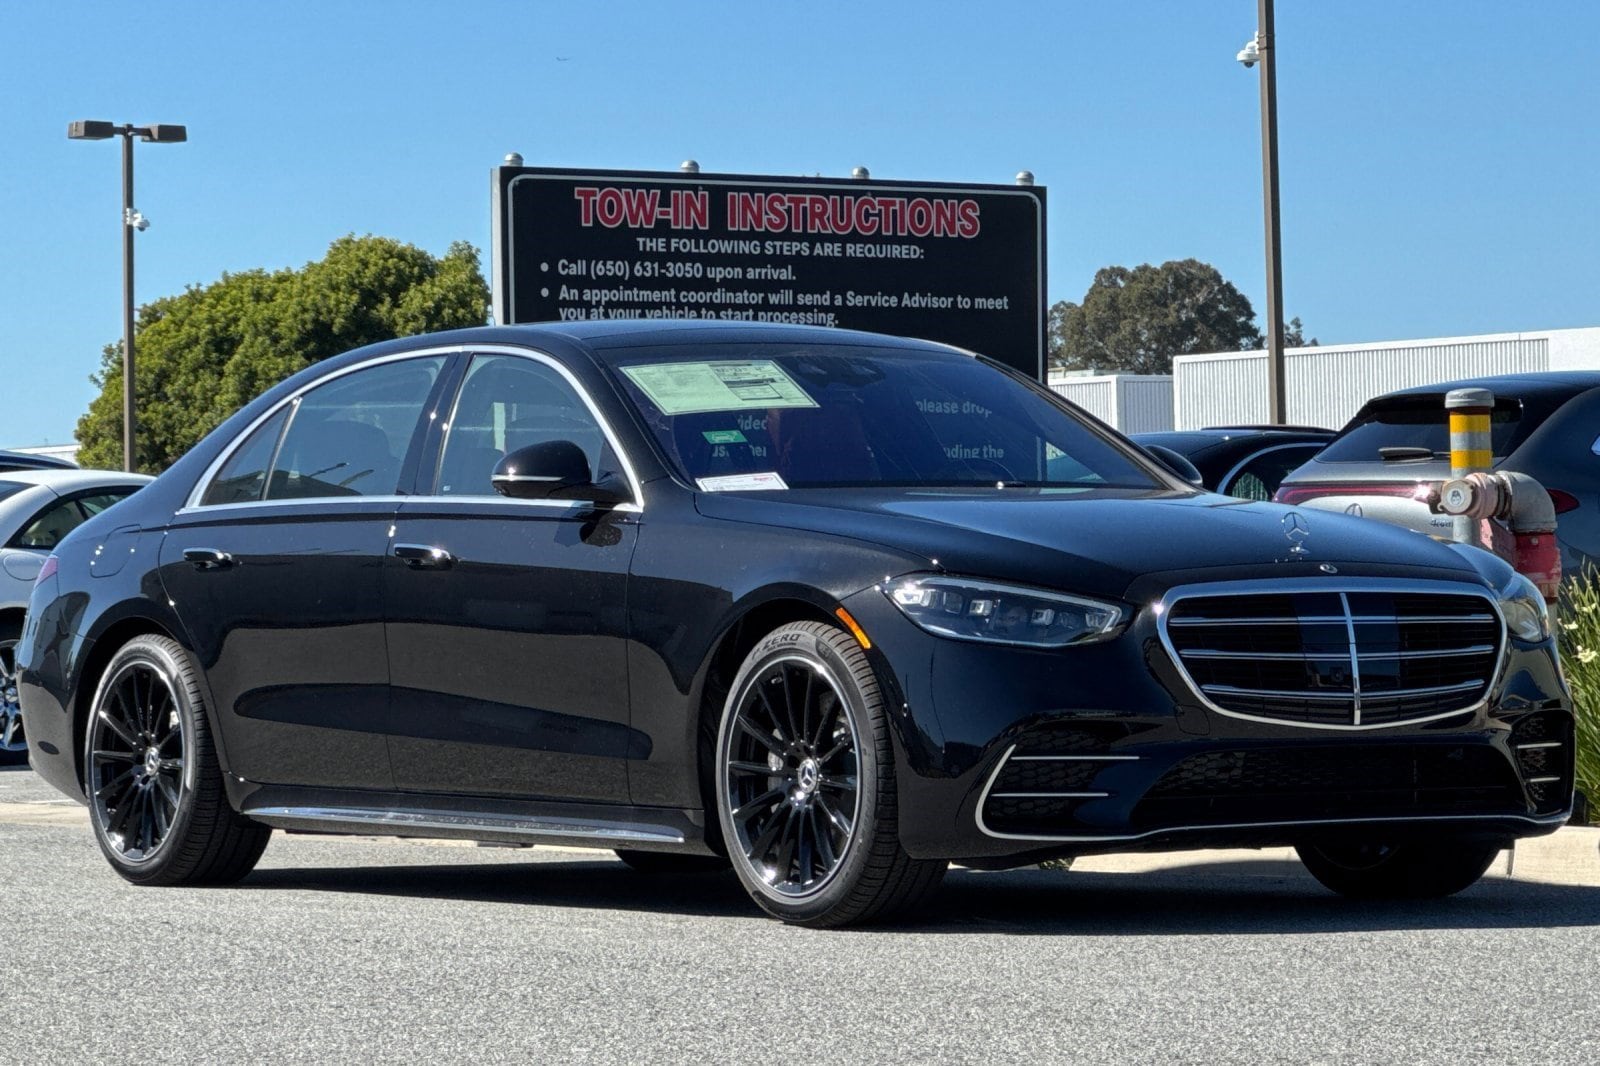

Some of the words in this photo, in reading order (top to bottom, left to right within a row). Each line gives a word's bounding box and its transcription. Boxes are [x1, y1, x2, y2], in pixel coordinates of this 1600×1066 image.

[574, 187, 709, 230] TOW-IN
[727, 191, 980, 239] INSTRUCTIONS
[636, 237, 667, 252] THE
[670, 239, 761, 254] FOLLOWING
[764, 241, 810, 256] STEPS
[813, 242, 842, 257] ARE
[846, 243, 924, 259] REQUIRED:
[557, 259, 586, 275] Call
[590, 260, 630, 280] (650)
[633, 261, 702, 278] 631-3050
[707, 265, 743, 282] upon
[746, 264, 796, 281] arrival.
[558, 284, 578, 300] An
[582, 286, 676, 305] appointment
[679, 287, 764, 304] coordinator
[767, 289, 793, 305] will
[797, 290, 831, 306] send
[834, 294, 843, 306] a
[846, 291, 898, 307] Service
[901, 292, 953, 308] Advisor
[957, 294, 971, 309] to
[974, 295, 1009, 310] meet
[559, 307, 586, 320] you
[590, 305, 605, 320] at
[608, 308, 641, 319] your
[645, 305, 697, 319] vehicle
[700, 307, 716, 320] to
[720, 308, 754, 320] start
[758, 308, 839, 328] processing.
[982, 444, 1004, 458] the
